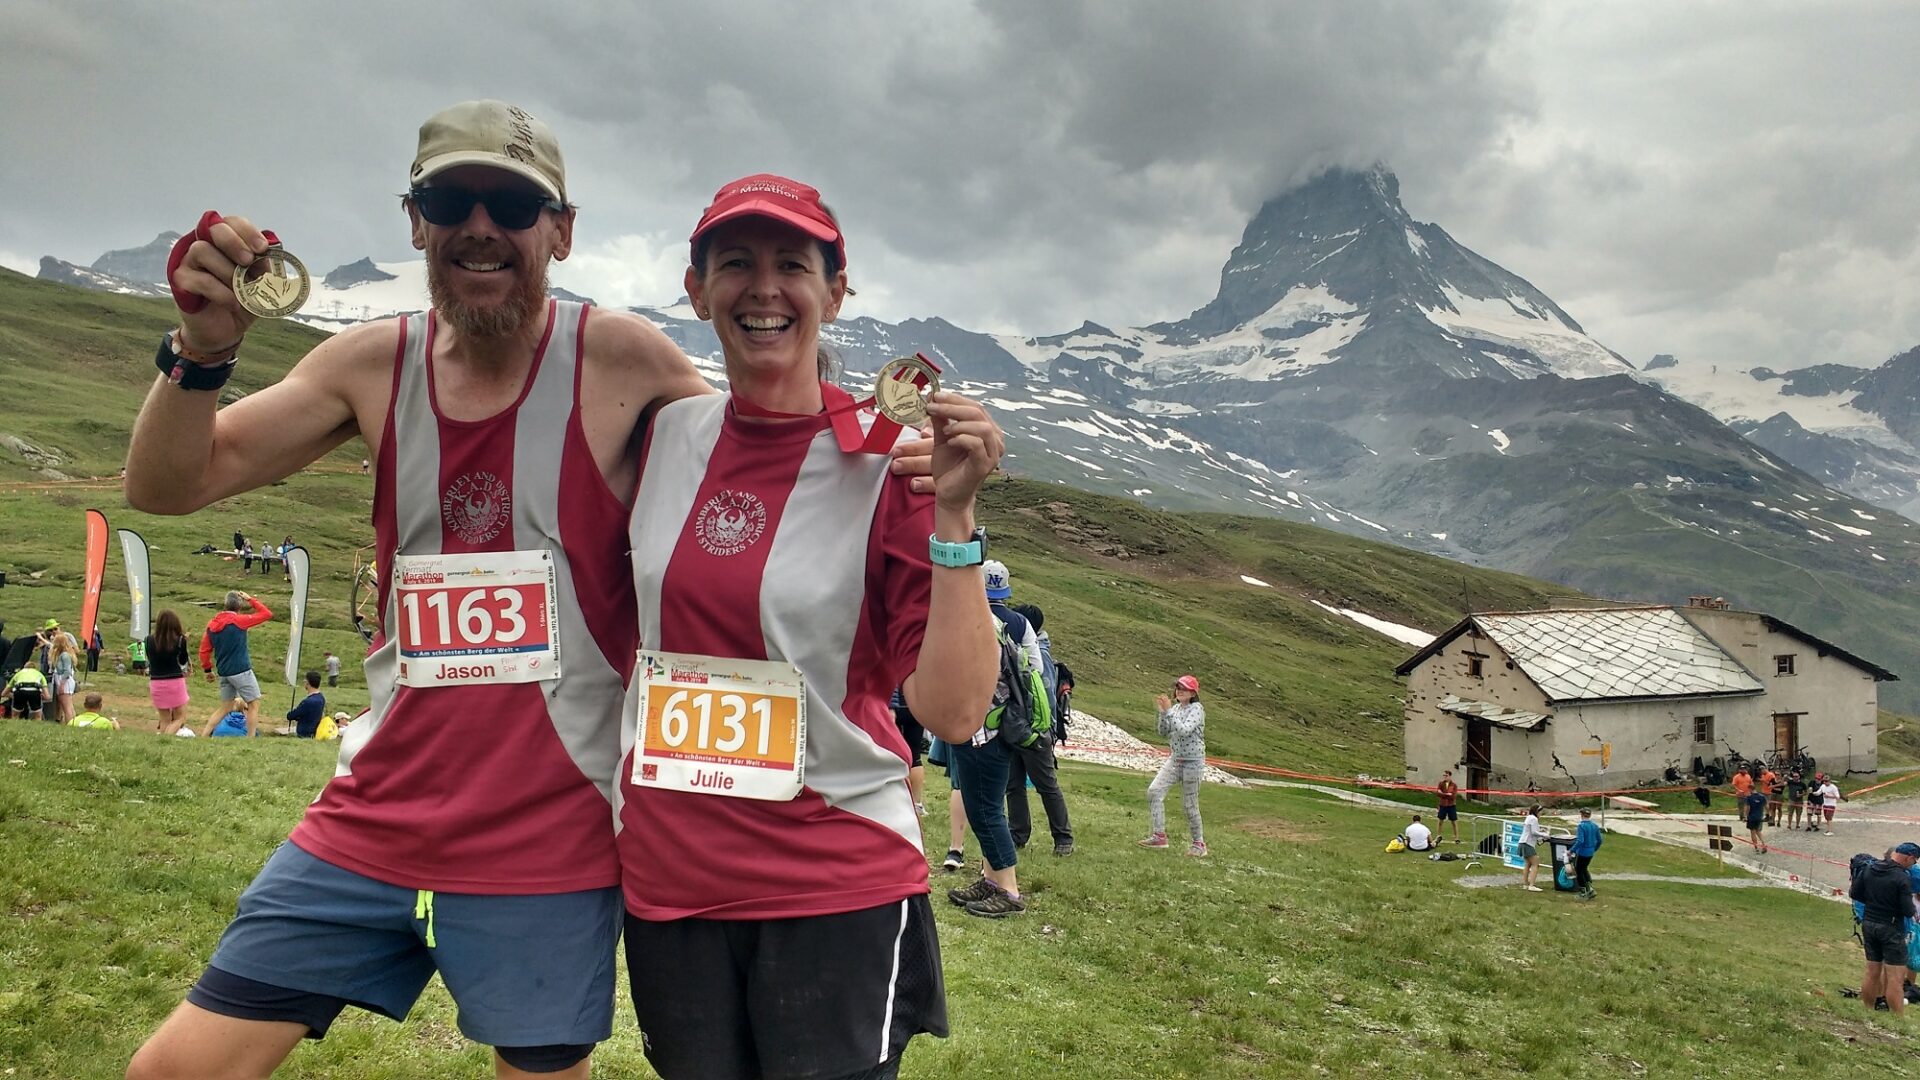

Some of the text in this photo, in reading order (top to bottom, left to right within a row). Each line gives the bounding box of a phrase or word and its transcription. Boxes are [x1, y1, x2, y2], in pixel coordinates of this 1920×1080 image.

[740, 186, 799, 200] Marathon
[443, 472, 510, 532] KIMBERLEY AND DISTRICT
[696, 489, 767, 546] KIMBERLEY AND DISTRICT
[458, 528, 500, 544] STRIDERS
[698, 538, 746, 556] STRIDERS
[402, 572, 443, 580] Marathon
[988, 574, 1003, 588] NY
[402, 588, 527, 646] 1163
[432, 648, 466, 657] schönsten
[467, 648, 483, 656] Berg
[436, 664, 495, 680] Jason
[672, 668, 708, 679] Marathon
[661, 690, 772, 756] 6131
[684, 754, 716, 762] schönsten
[718, 756, 732, 764] Berg
[690, 769, 734, 789] Julie
